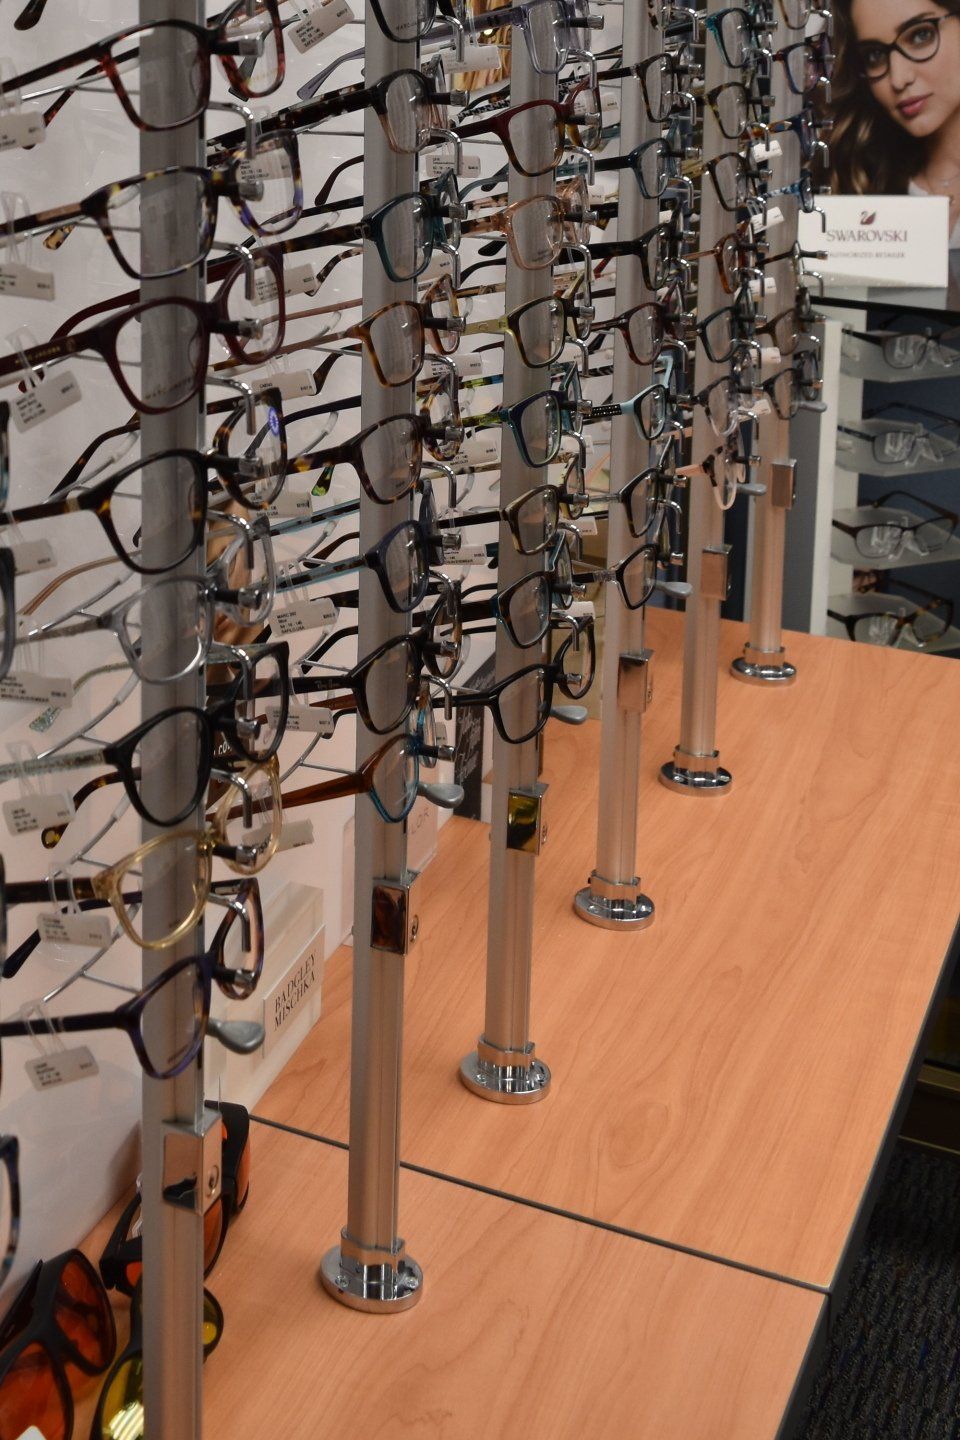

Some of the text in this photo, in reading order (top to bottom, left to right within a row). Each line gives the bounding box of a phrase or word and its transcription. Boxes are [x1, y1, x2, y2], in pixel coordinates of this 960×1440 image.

[826, 229, 908, 242] SWAROVSKI
[274, 970, 316, 1031] MISCHKA
[275, 950, 316, 1013] BADGLEY
